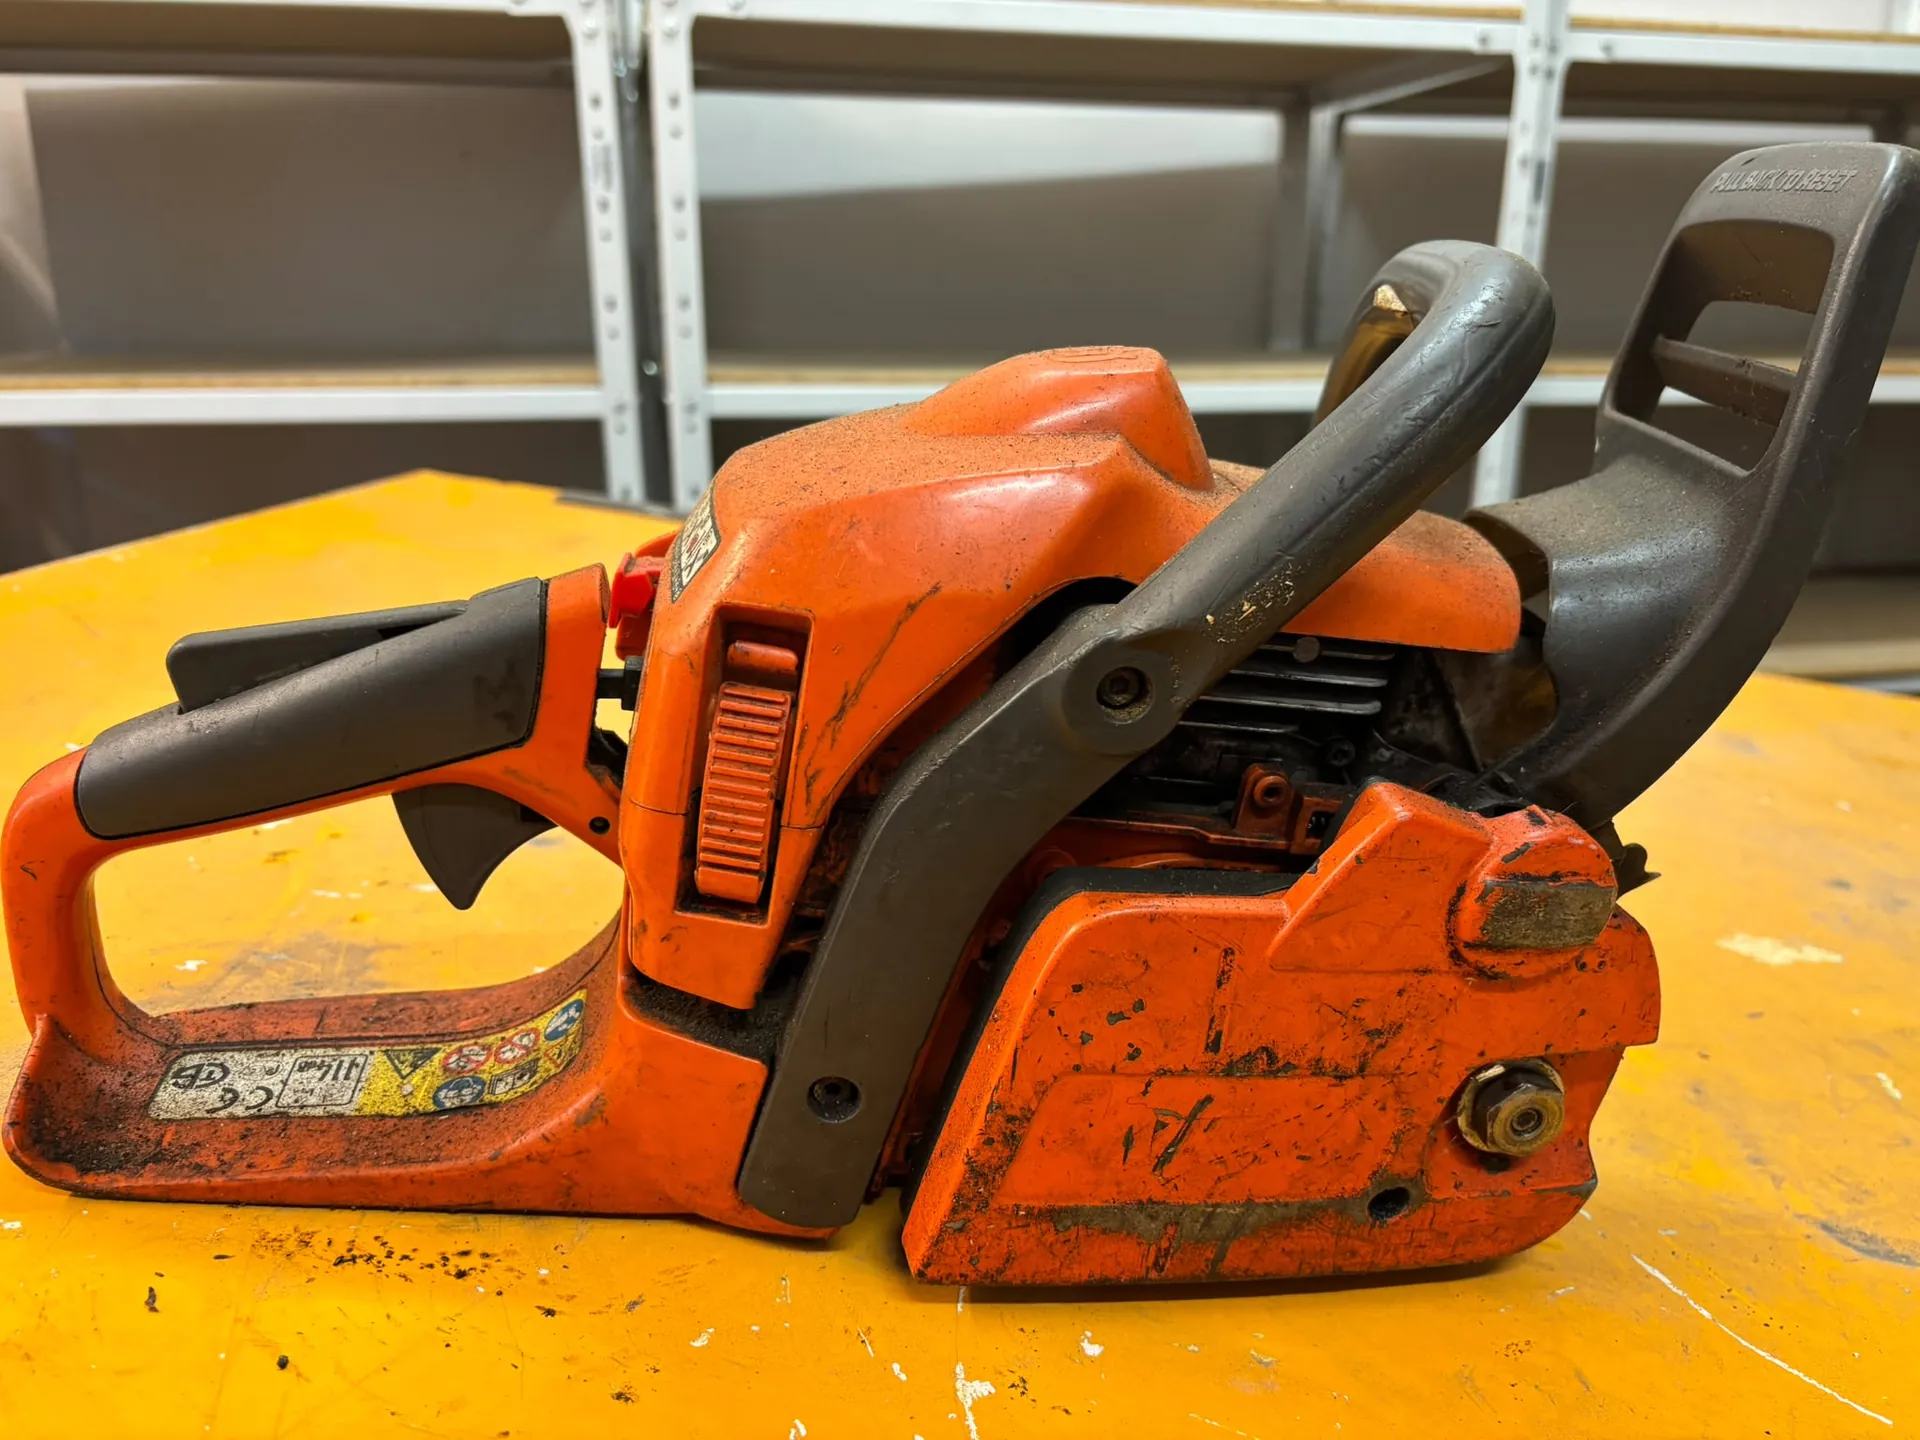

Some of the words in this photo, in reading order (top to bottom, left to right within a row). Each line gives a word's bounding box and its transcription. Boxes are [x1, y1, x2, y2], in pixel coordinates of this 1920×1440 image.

[1709, 171, 1746, 194] PULL
[1738, 170, 1781, 193] BACK
[1776, 168, 1803, 193] TO
[1796, 167, 1859, 193] RESET
